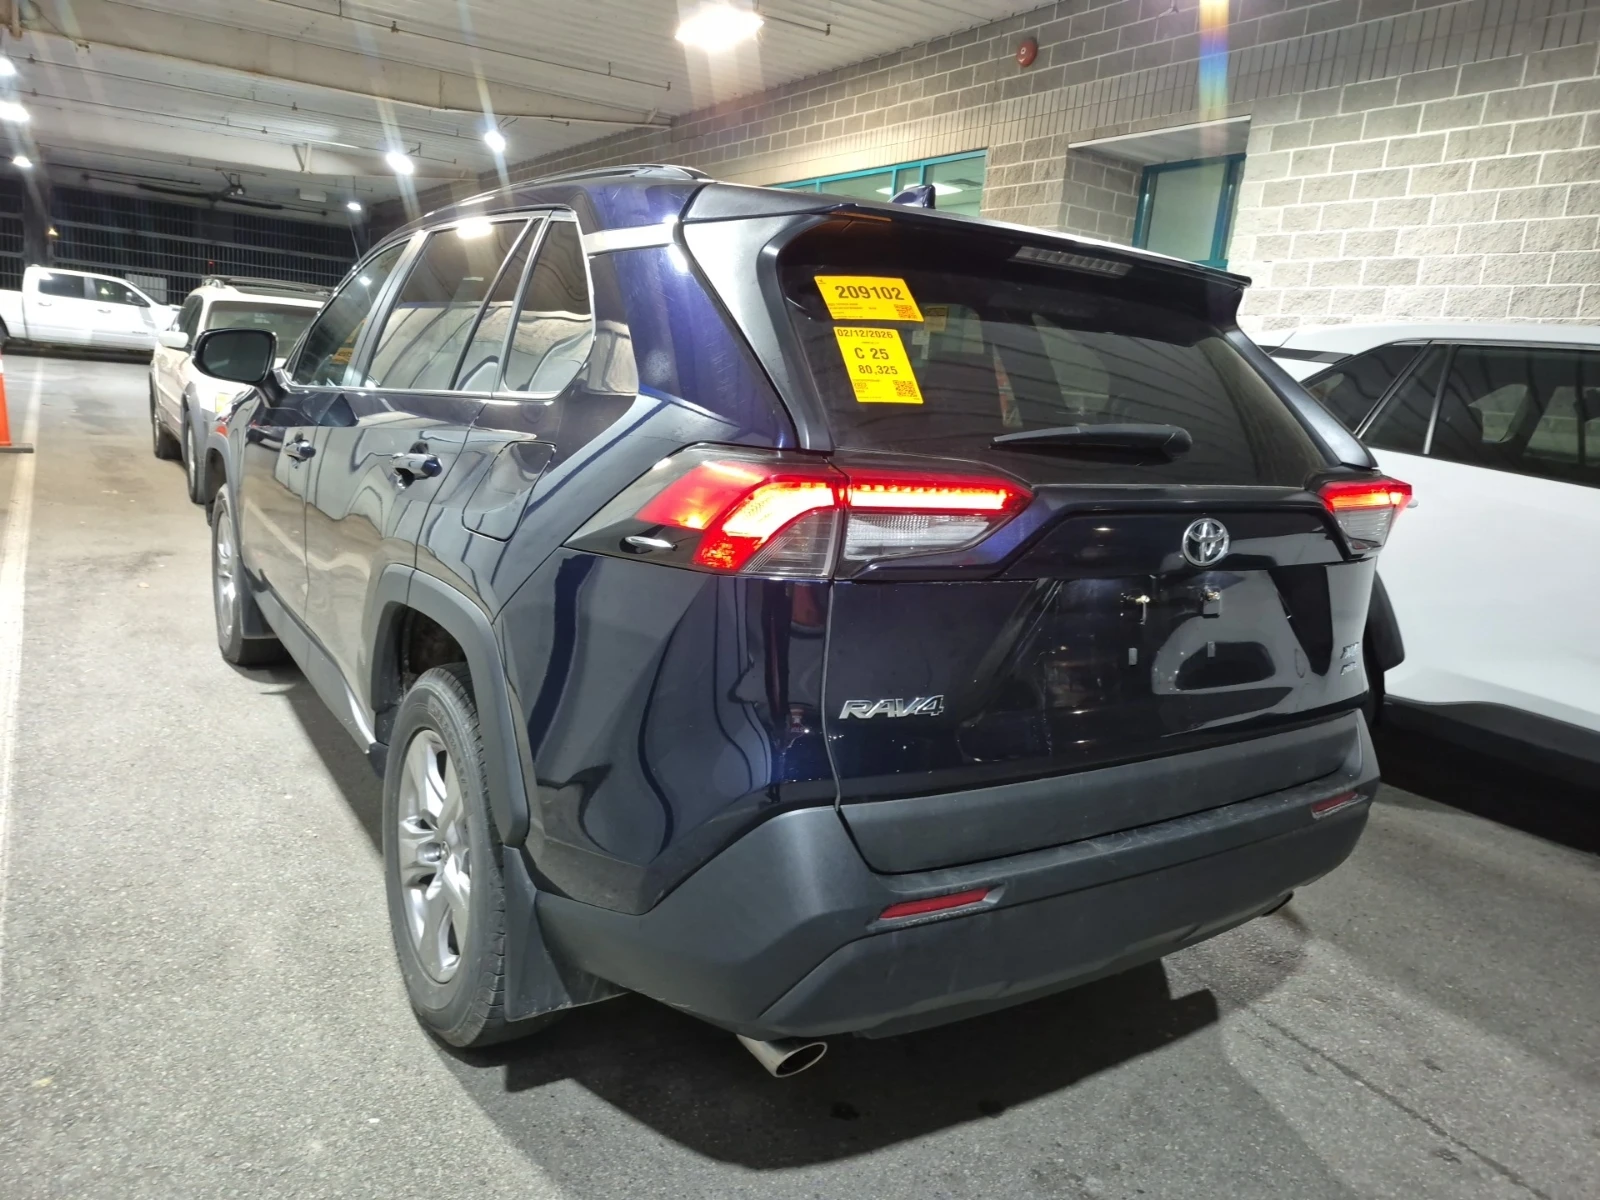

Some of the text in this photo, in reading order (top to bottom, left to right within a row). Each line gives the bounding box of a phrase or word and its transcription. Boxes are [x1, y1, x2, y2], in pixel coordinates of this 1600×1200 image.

[834, 285, 905, 301] 209102
[854, 347, 890, 360] C 25
[858, 364, 898, 375] 80,325
[838, 695, 944, 720] RAV4
